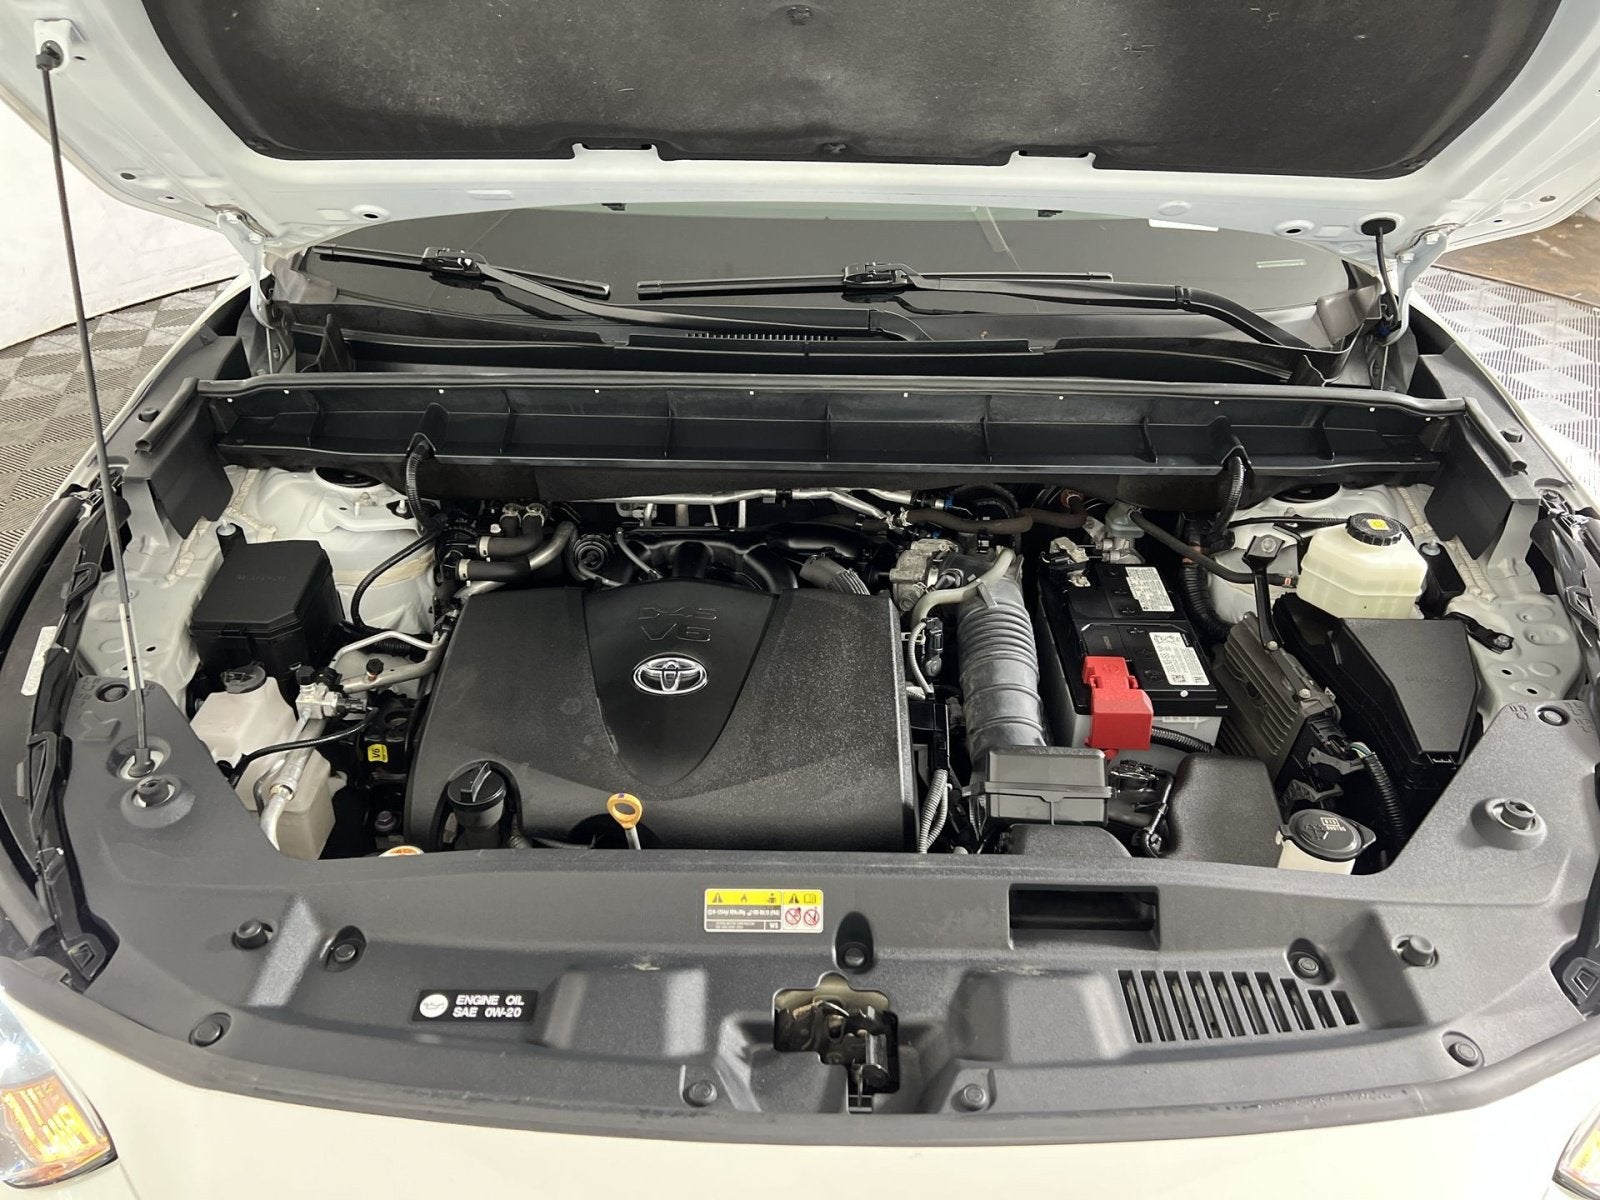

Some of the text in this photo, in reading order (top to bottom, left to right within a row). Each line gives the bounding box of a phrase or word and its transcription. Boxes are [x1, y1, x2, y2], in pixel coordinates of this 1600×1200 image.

[455, 994, 525, 1006] ENGINE OIL
[452, 1007, 522, 1018] SAE 0W-20
